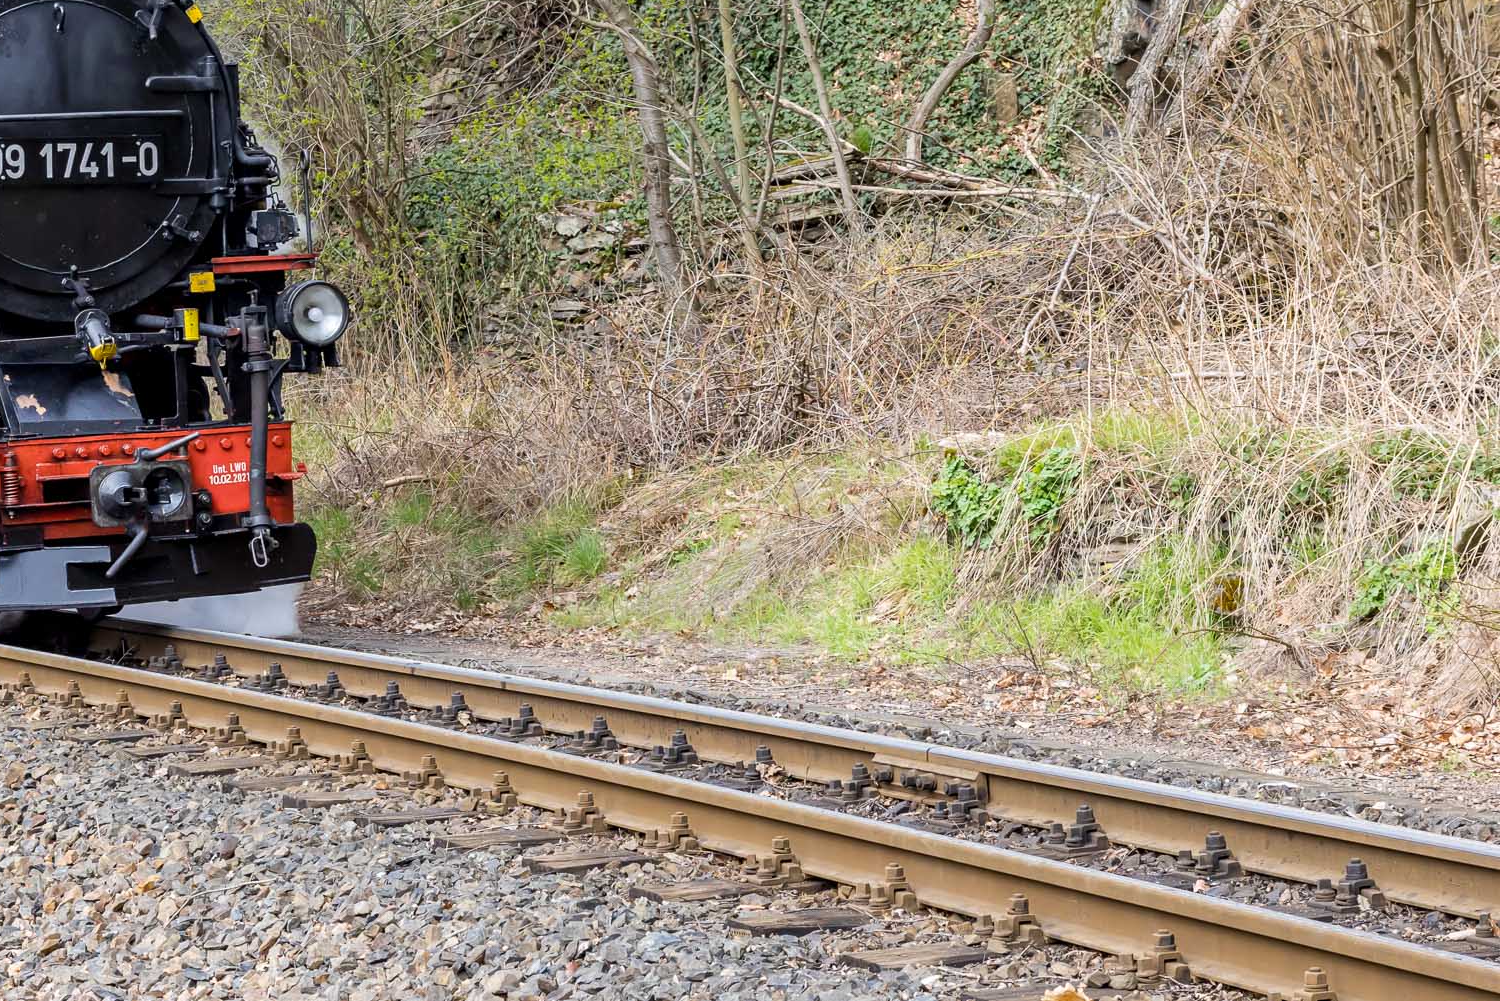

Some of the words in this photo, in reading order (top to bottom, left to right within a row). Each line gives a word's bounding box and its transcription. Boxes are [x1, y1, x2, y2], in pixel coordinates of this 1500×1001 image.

[39, 141, 158, 179] 1741-0
[212, 464, 228, 474] Unt.
[209, 472, 250, 485] 10.02.2021
